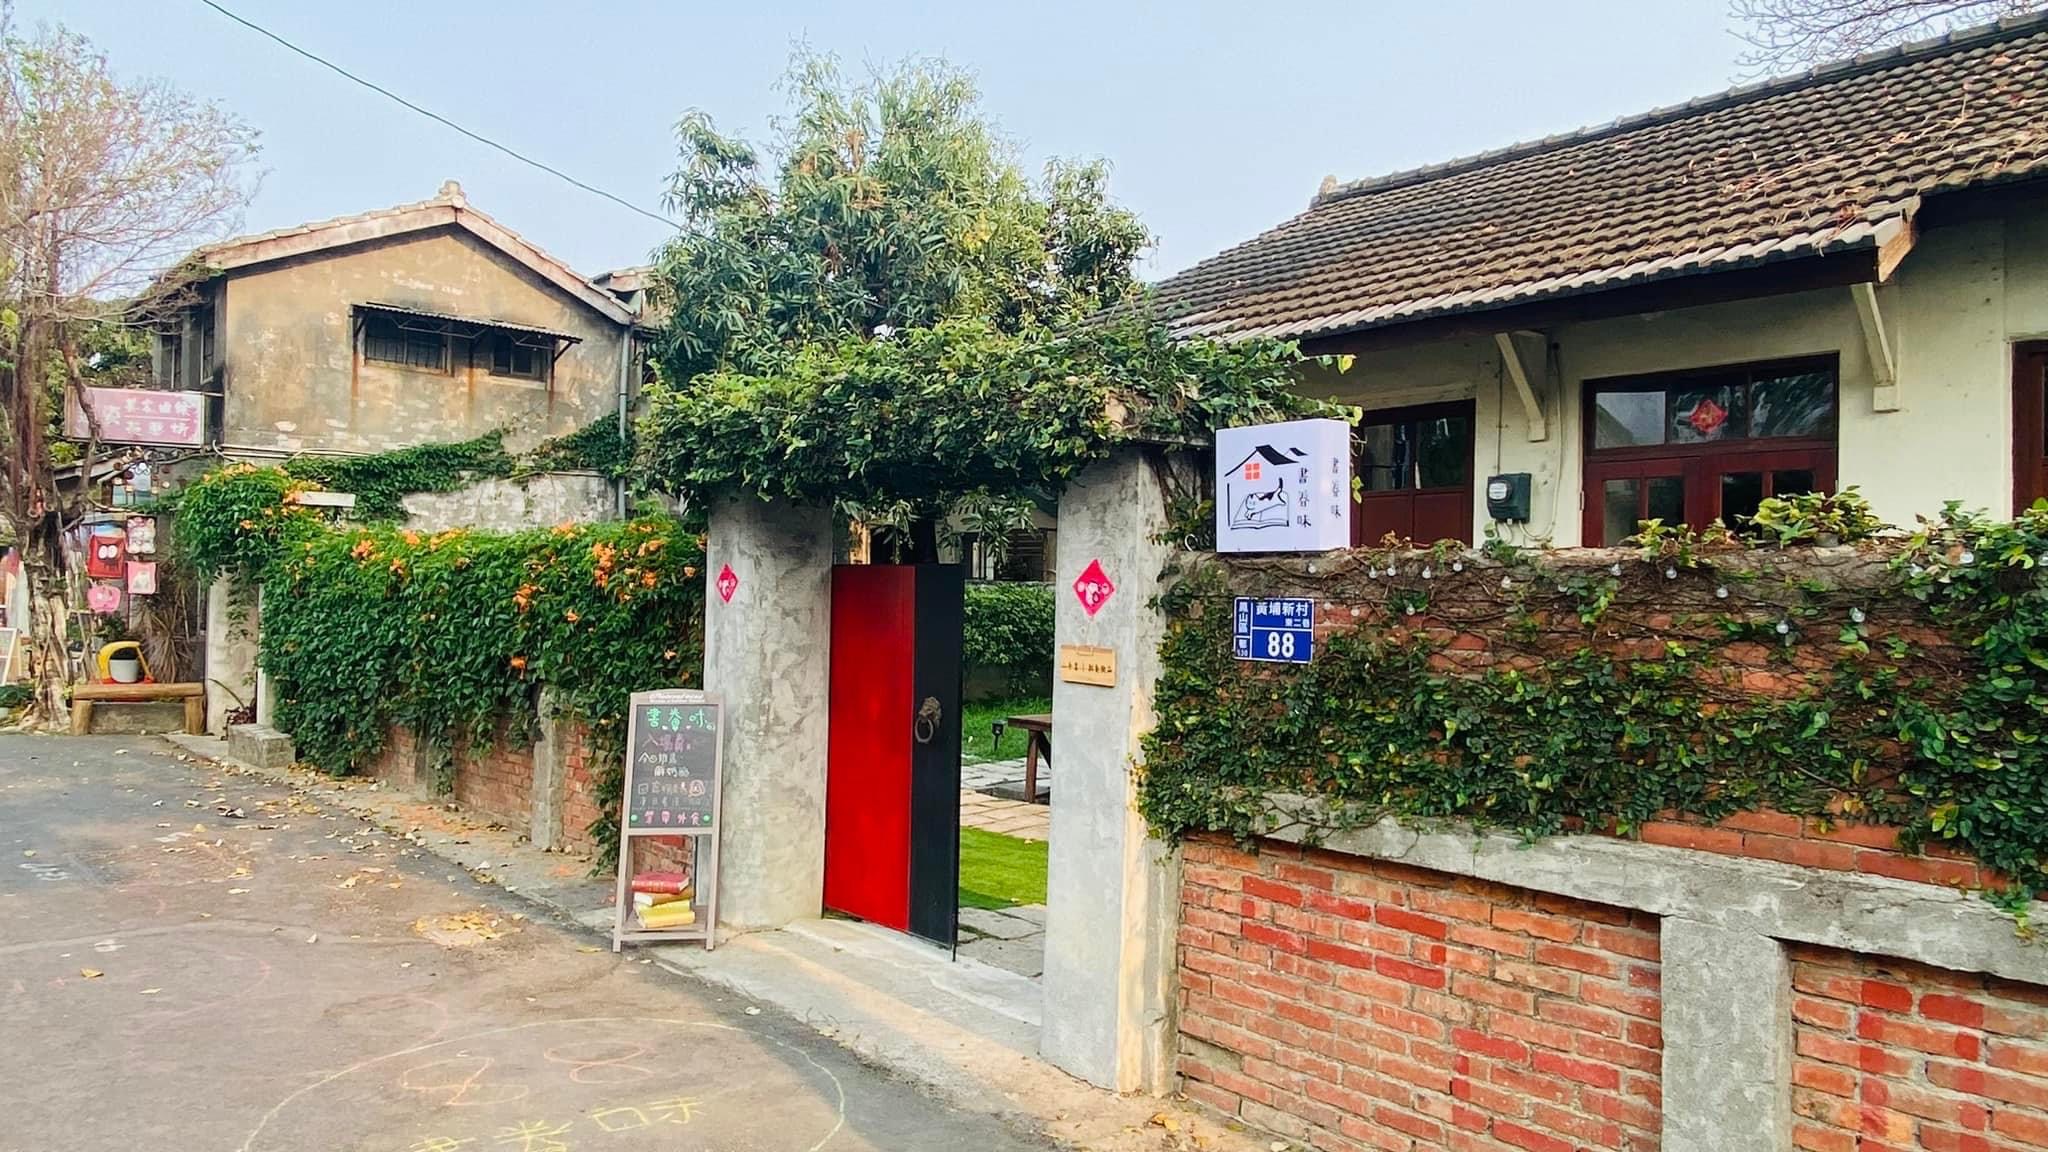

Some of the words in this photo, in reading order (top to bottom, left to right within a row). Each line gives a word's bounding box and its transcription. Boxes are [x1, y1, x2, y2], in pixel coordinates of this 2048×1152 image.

[1238, 601, 1248, 633] 鳳山區
[1255, 601, 1308, 616] 黃埔新村
[1268, 632, 1294, 658] 88
